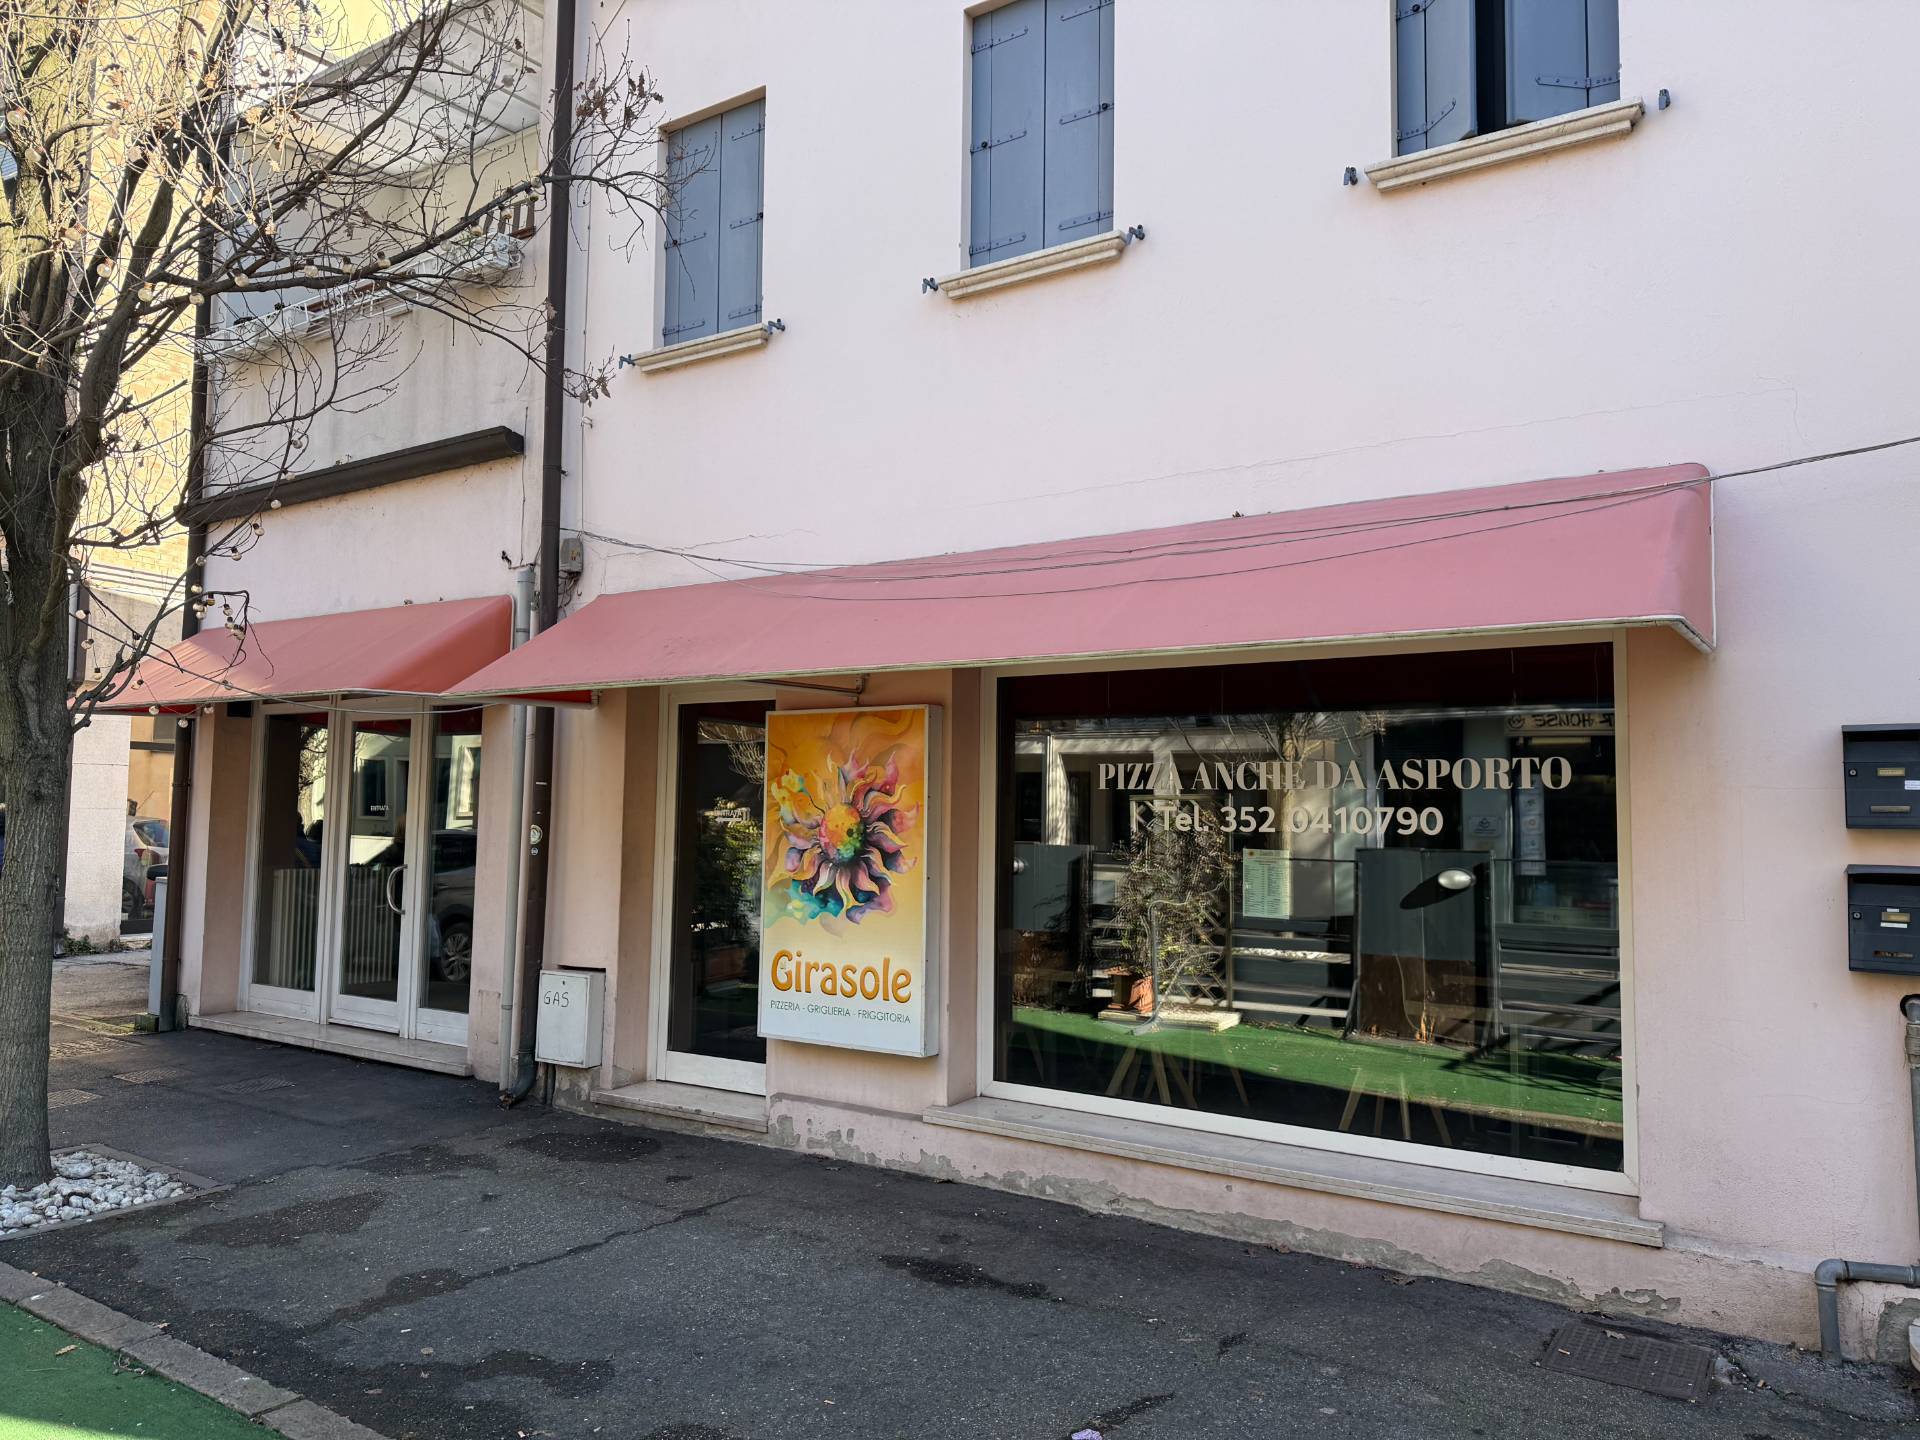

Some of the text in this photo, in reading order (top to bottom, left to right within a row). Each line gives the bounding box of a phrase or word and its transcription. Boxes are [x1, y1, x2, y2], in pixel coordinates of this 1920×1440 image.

[1097, 756, 1572, 790] PIZZA ANCHE DA ASPORTO
[1158, 805, 1209, 832] Tel.
[1220, 806, 1276, 833] 352
[1291, 805, 1444, 836] 0410790
[771, 949, 912, 1004] Girasole
[543, 990, 570, 1008] GAS
[770, 1000, 801, 1012] PIZZERIA
[807, 1004, 851, 1017] GRIGLIERIA
[858, 1010, 911, 1024] FRIGGITORIA
